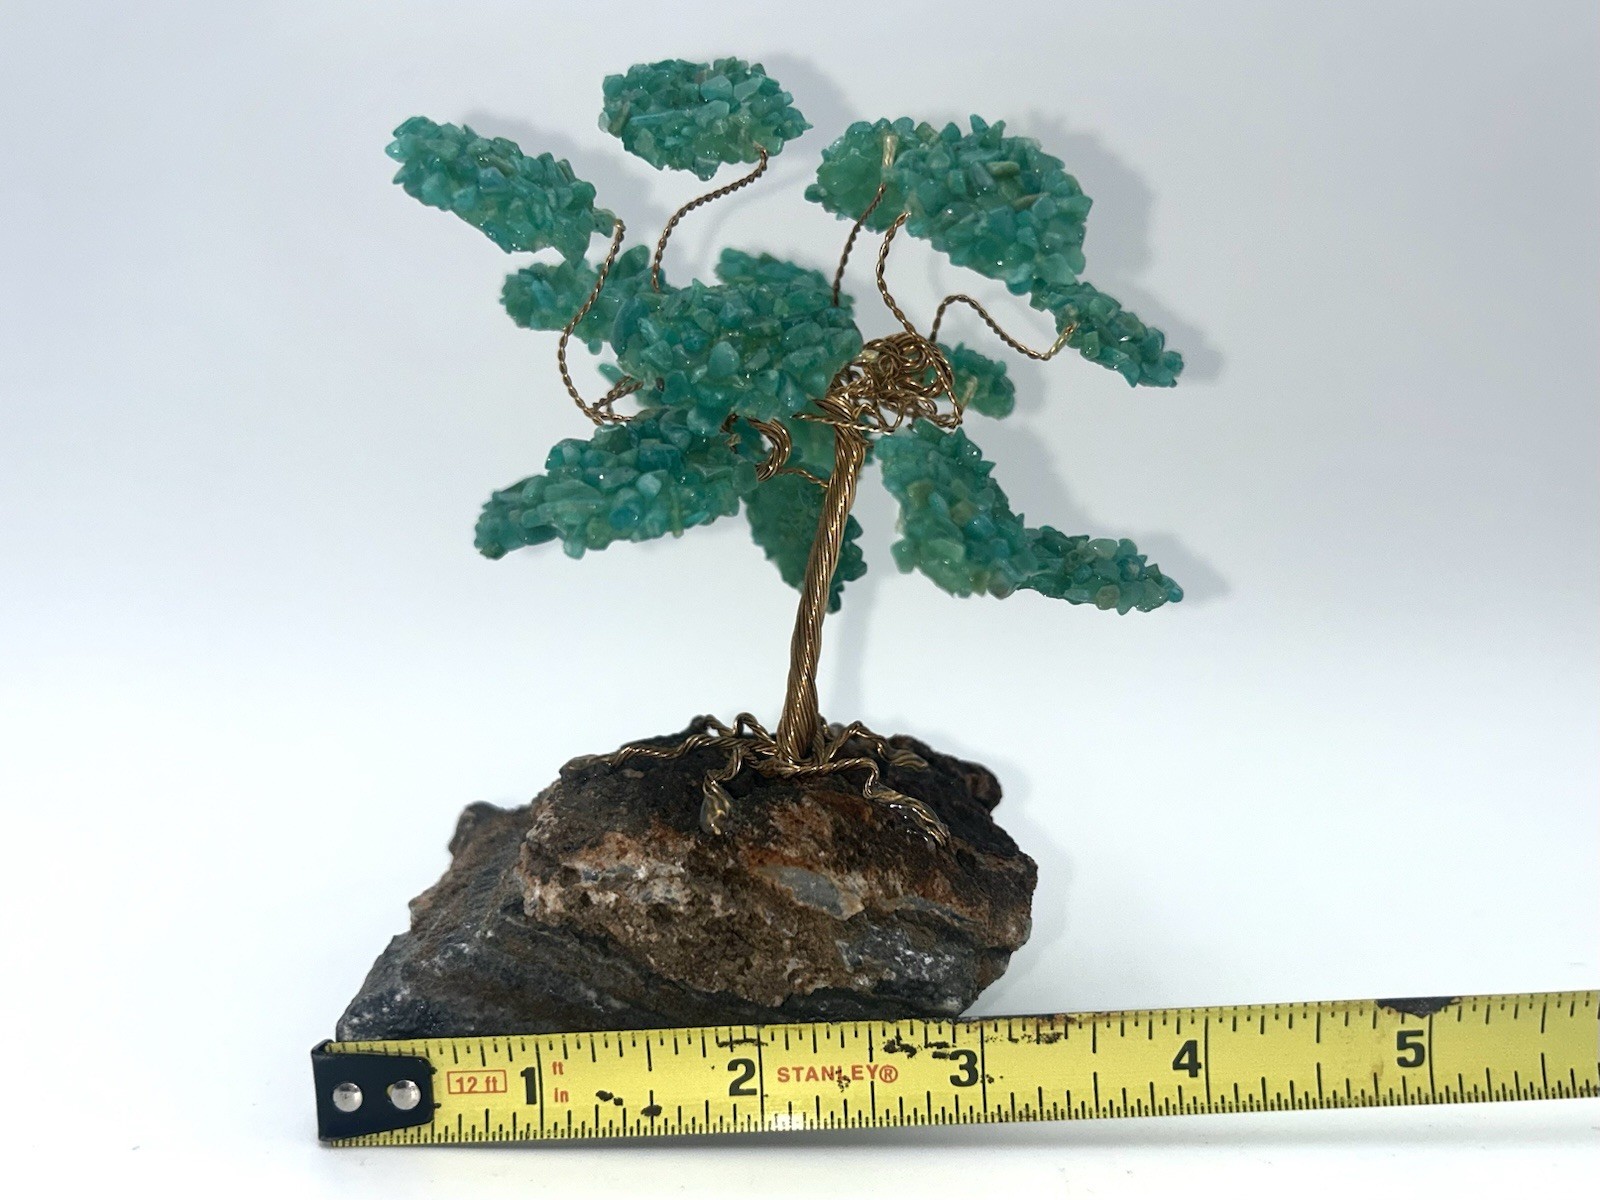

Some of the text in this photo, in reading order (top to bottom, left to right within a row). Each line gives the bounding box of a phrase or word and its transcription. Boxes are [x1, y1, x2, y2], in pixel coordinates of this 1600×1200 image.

[949, 1049, 979, 1087] 3
[1172, 1040, 1201, 1078] 4
[1396, 1030, 1425, 1068] 5
[455, 1076, 498, 1093] 12 ft
[520, 1067, 537, 1105] 1
[727, 1058, 757, 1096] 2
